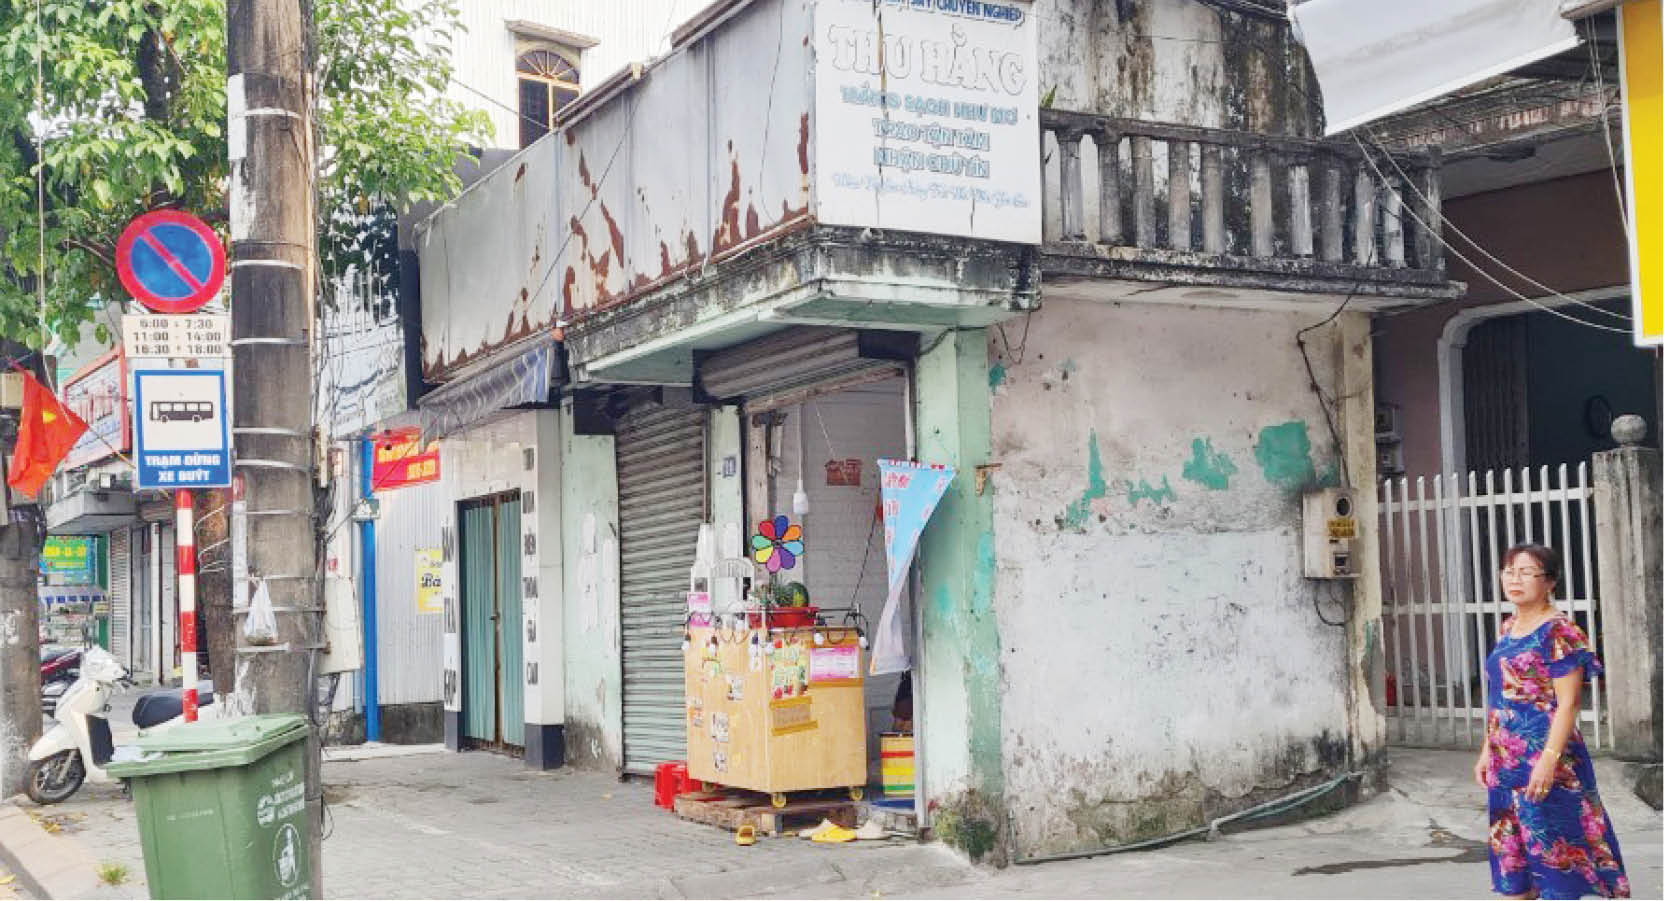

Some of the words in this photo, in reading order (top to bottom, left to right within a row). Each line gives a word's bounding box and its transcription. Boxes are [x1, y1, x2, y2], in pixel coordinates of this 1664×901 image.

[827, 24, 911, 79] THU
[133, 331, 168, 341] 11:00
[186, 331, 221, 341] 14:00
[145, 454, 181, 469] TRẠM
[184, 451, 221, 466] DỪNG
[157, 470, 175, 482] XE
[178, 467, 210, 481] BUÝT
